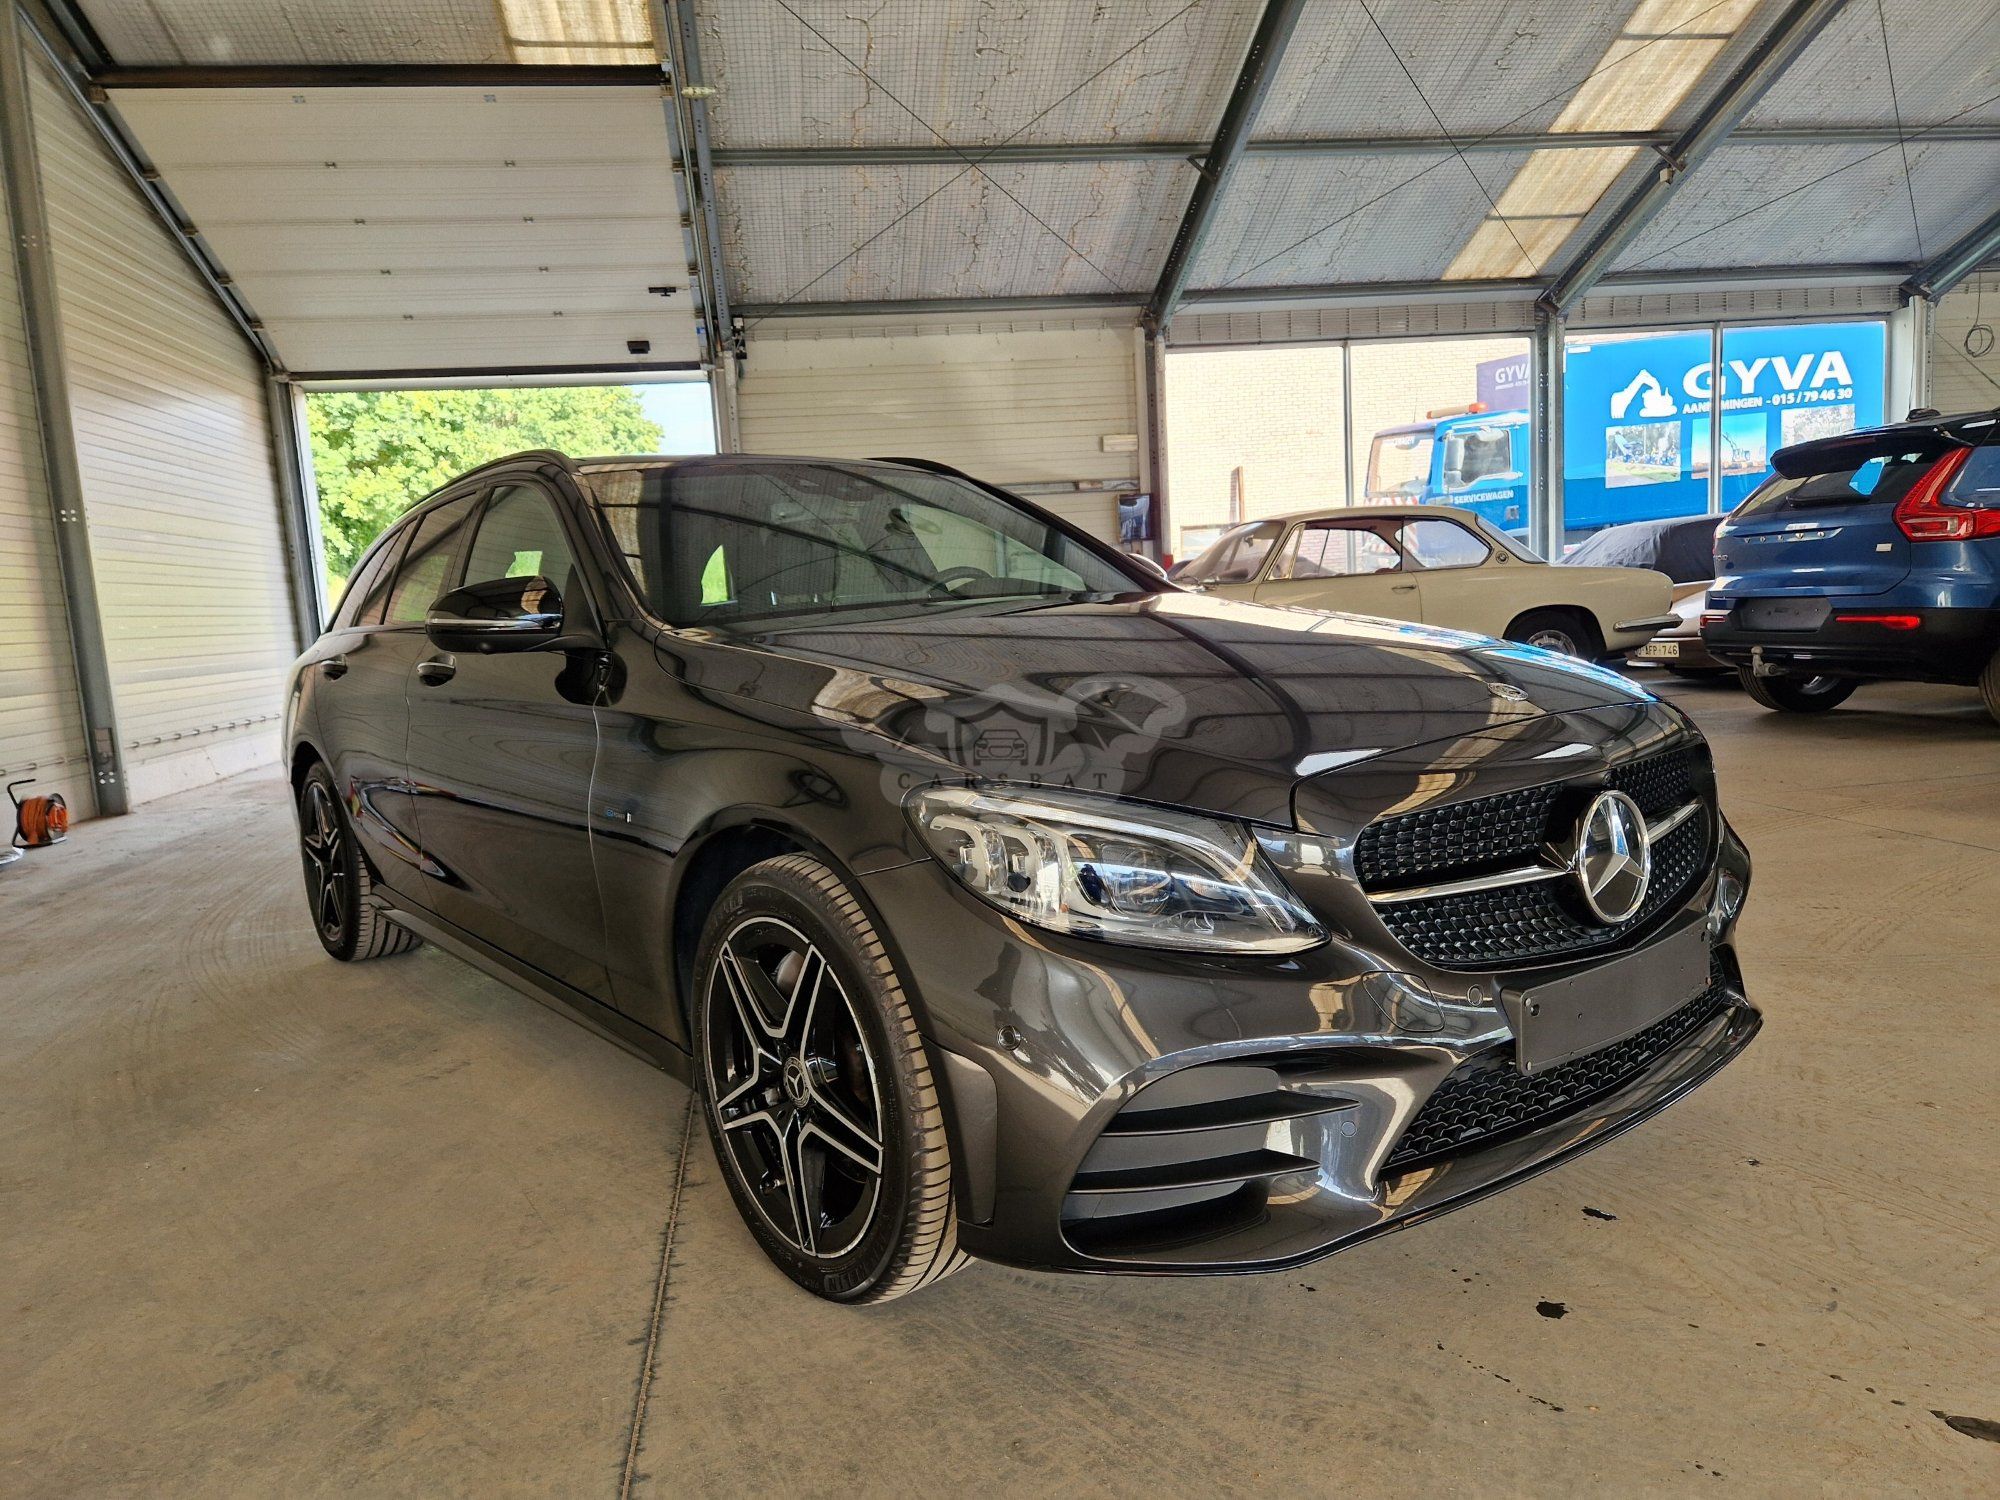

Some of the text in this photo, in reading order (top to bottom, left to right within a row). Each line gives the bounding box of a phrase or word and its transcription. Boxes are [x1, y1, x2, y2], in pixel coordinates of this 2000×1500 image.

[1495, 363, 1530, 384] GYV
[1682, 351, 1853, 398] GYVA
[1454, 489, 1515, 504] SERVICEWAGEN
